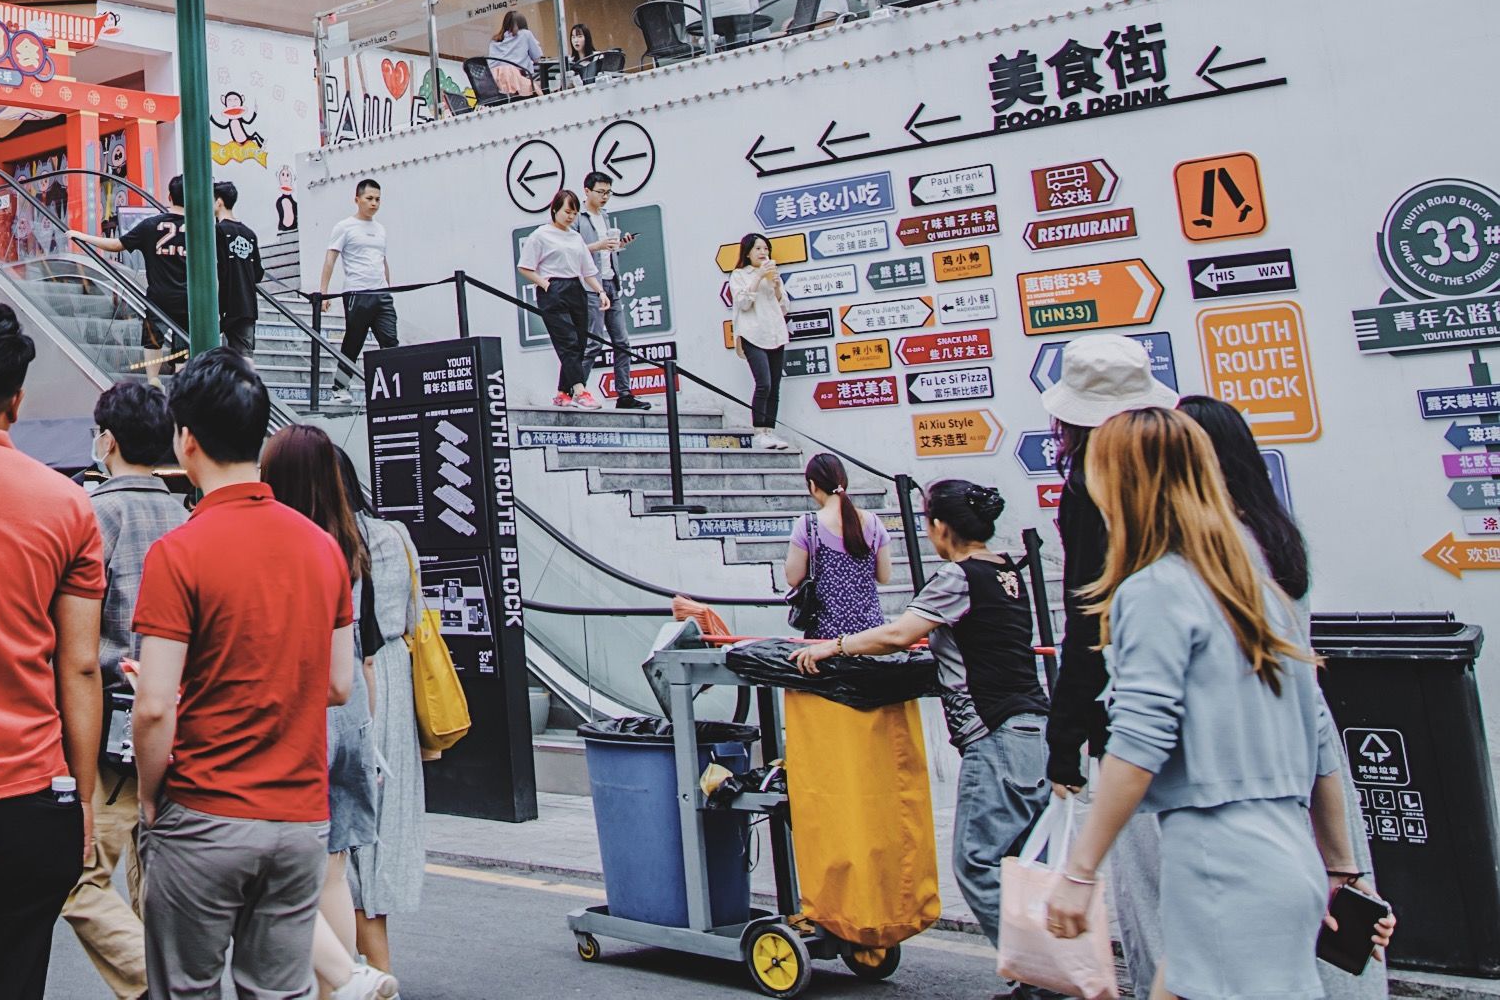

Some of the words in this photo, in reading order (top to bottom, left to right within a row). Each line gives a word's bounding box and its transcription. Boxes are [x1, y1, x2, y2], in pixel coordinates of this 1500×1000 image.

[988, 22, 1168, 114] 美食街
[994, 105, 1060, 131] FOOD
[1065, 101, 1082, 117] &
[1087, 85, 1170, 116] DRINK
[930, 175, 952, 186] Paul
[955, 170, 984, 181] Frank
[775, 182, 882, 222] 美食&小吃
[1049, 187, 1092, 207] 公交站
[1400, 202, 1426, 231] YOUTH
[1427, 195, 1456, 208] ROAD
[1458, 197, 1493, 222] BLOCK
[827, 233, 844, 242] Rong
[845, 231, 855, 239] Pu
[856, 229, 872, 238] Tian
[873, 227, 885, 235] Pin
[927, 233, 936, 242] QI
[936, 230, 950, 239] WEI
[952, 228, 962, 237] PU
[963, 227, 971, 235] ZI
[971, 225, 985, 233] NIU
[986, 223, 997, 232] ZA
[1038, 215, 1129, 243] RESTAURANT
[1399, 240, 1412, 263] LOVE
[1412, 262, 1427, 279] ALL
[1429, 271, 1443, 284] OF
[1443, 276, 1465, 286] THE
[1465, 251, 1500, 284] STREETS
[1208, 270, 1235, 283] THIS
[1258, 264, 1284, 277] WAY
[803, 280, 844, 294] 尖叫小串
[1034, 304, 1091, 326] (HN33)
[937, 336, 962, 345] SNACK
[963, 334, 978, 342] BAR
[1210, 319, 1292, 347] YOUTH
[1422, 331, 1454, 342] YOUTH
[1454, 327, 1486, 338] ROUTE
[646, 345, 672, 360] FOOD
[929, 345, 989, 360] 些几好友记
[1214, 347, 1297, 374] ROUTE
[447, 357, 472, 368] YOUTH
[370, 367, 401, 400] A1
[423, 370, 447, 381] ROUTE
[448, 367, 472, 379] BLOCK
[920, 378, 933, 387] Fu
[935, 376, 946, 385] Le
[948, 374, 958, 384] Si
[961, 373, 987, 383] Pizza
[424, 379, 474, 395] 青年公路街区
[837, 379, 893, 399] 港式美食
[1219, 375, 1302, 402] BLOCK
[486, 370, 508, 447] YOUTH
[918, 420, 928, 430] Ai
[930, 420, 945, 429] Xiu
[948, 418, 973, 430] Style
[919, 433, 969, 448] 艾秀造型
[493, 458, 516, 536] ROUTE
[500, 548, 523, 627] BLOCK
[1358, 765, 1399, 776] 其他垃圾
[1363, 773, 1379, 781] Other
